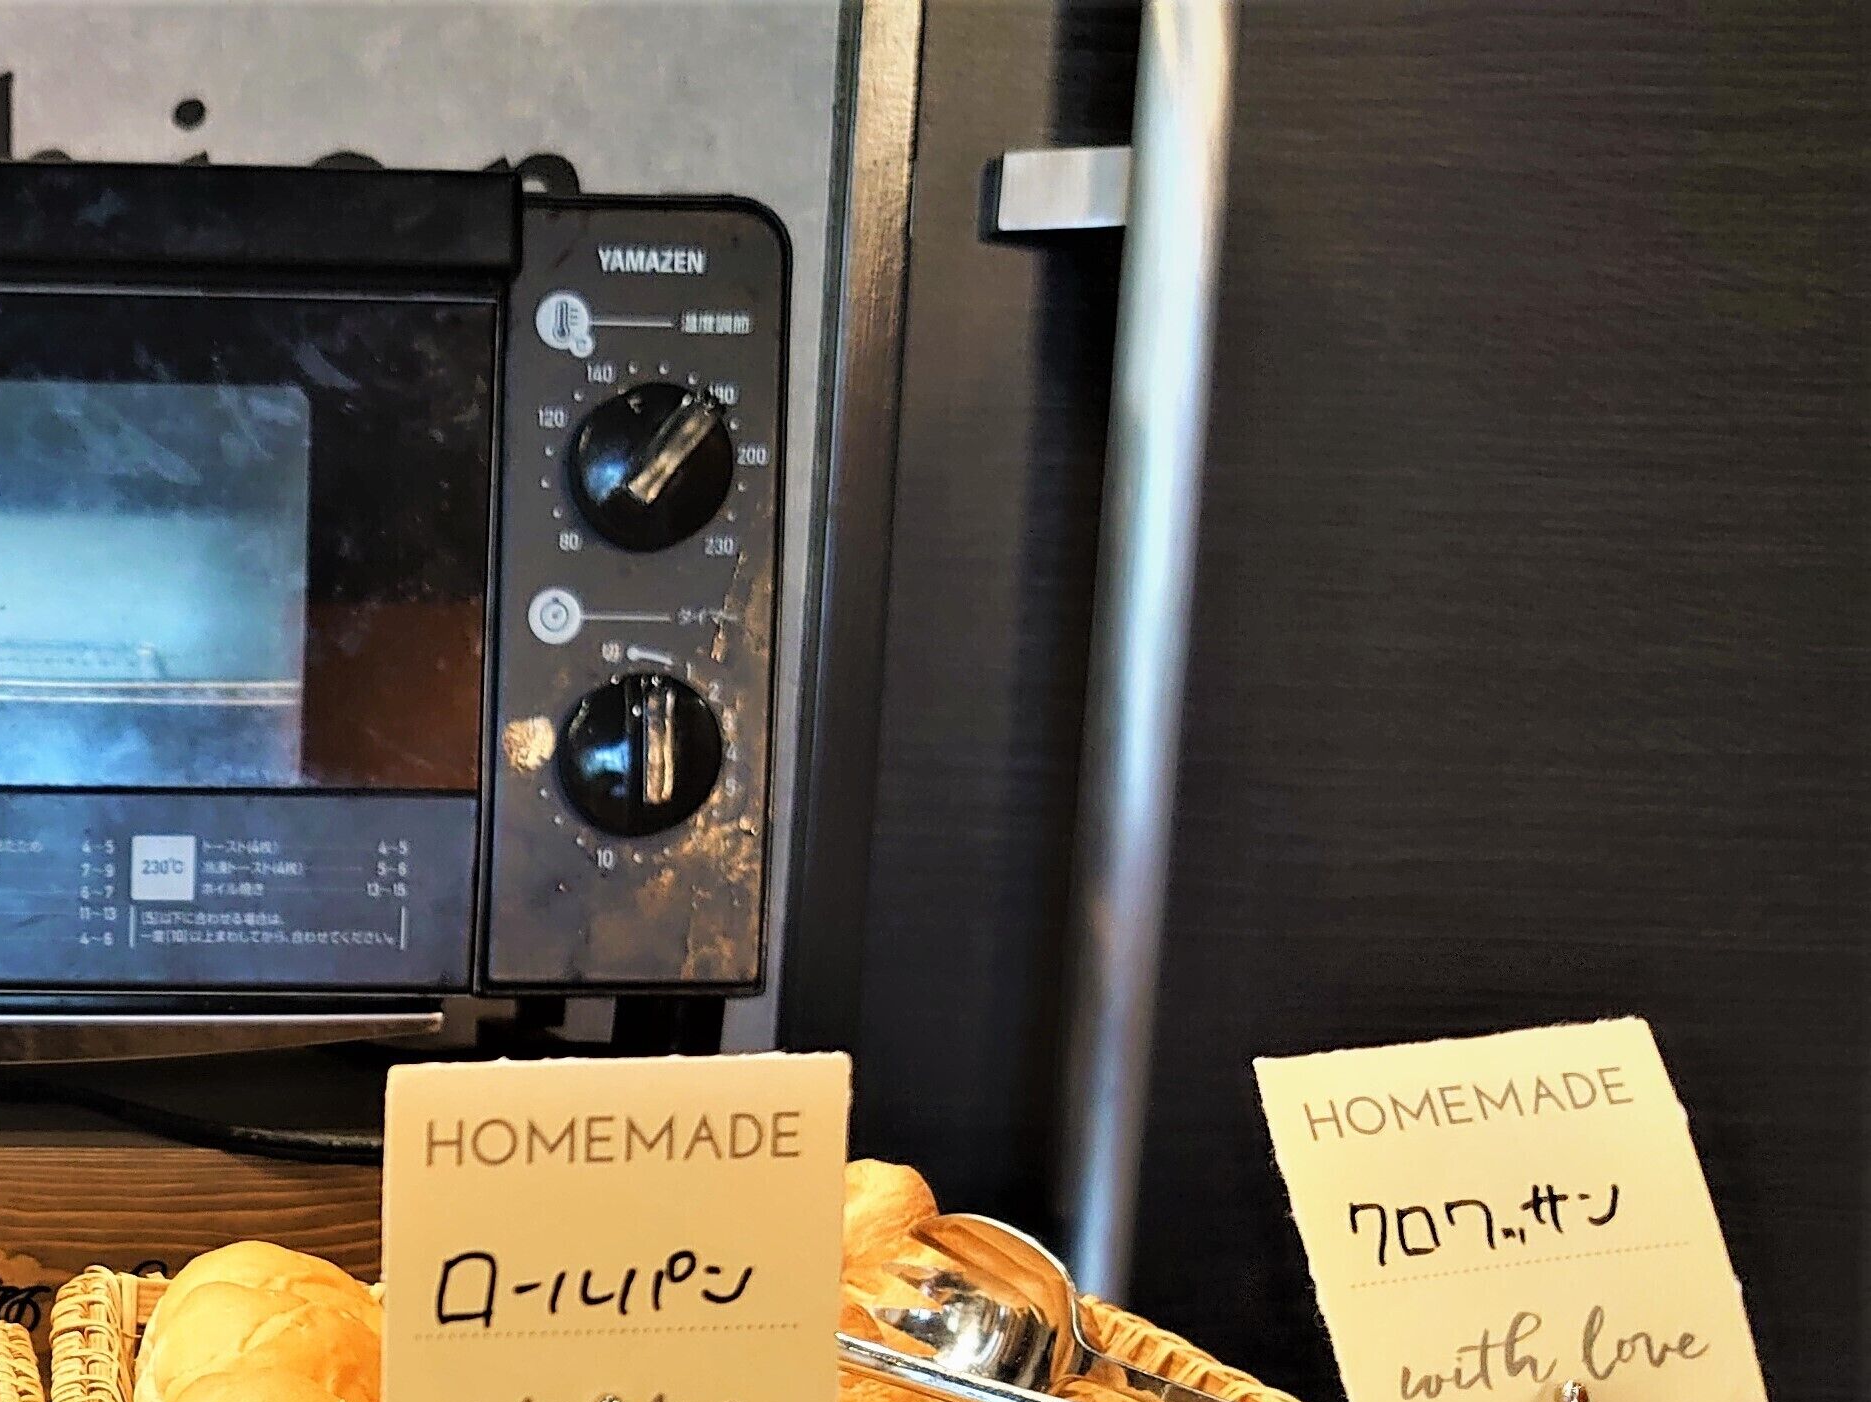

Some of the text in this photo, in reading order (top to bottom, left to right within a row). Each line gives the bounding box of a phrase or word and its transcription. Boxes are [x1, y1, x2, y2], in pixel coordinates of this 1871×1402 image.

[597, 247, 707, 274] YAMAZEN
[587, 363, 616, 384] 140
[538, 409, 566, 428] 120
[736, 445, 769, 465] 200
[558, 532, 582, 552] 80
[704, 538, 735, 557] 230
[141, 857, 184, 876] 230°C
[596, 848, 616, 869] 10
[1302, 1065, 1634, 1142] HOMEMADE
[425, 1110, 803, 1168] HOMEMADE
[1348, 1183, 1621, 1267] クロワッサン
[435, 1249, 755, 1329] ロールパン
[1399, 1304, 1711, 1401] with love
